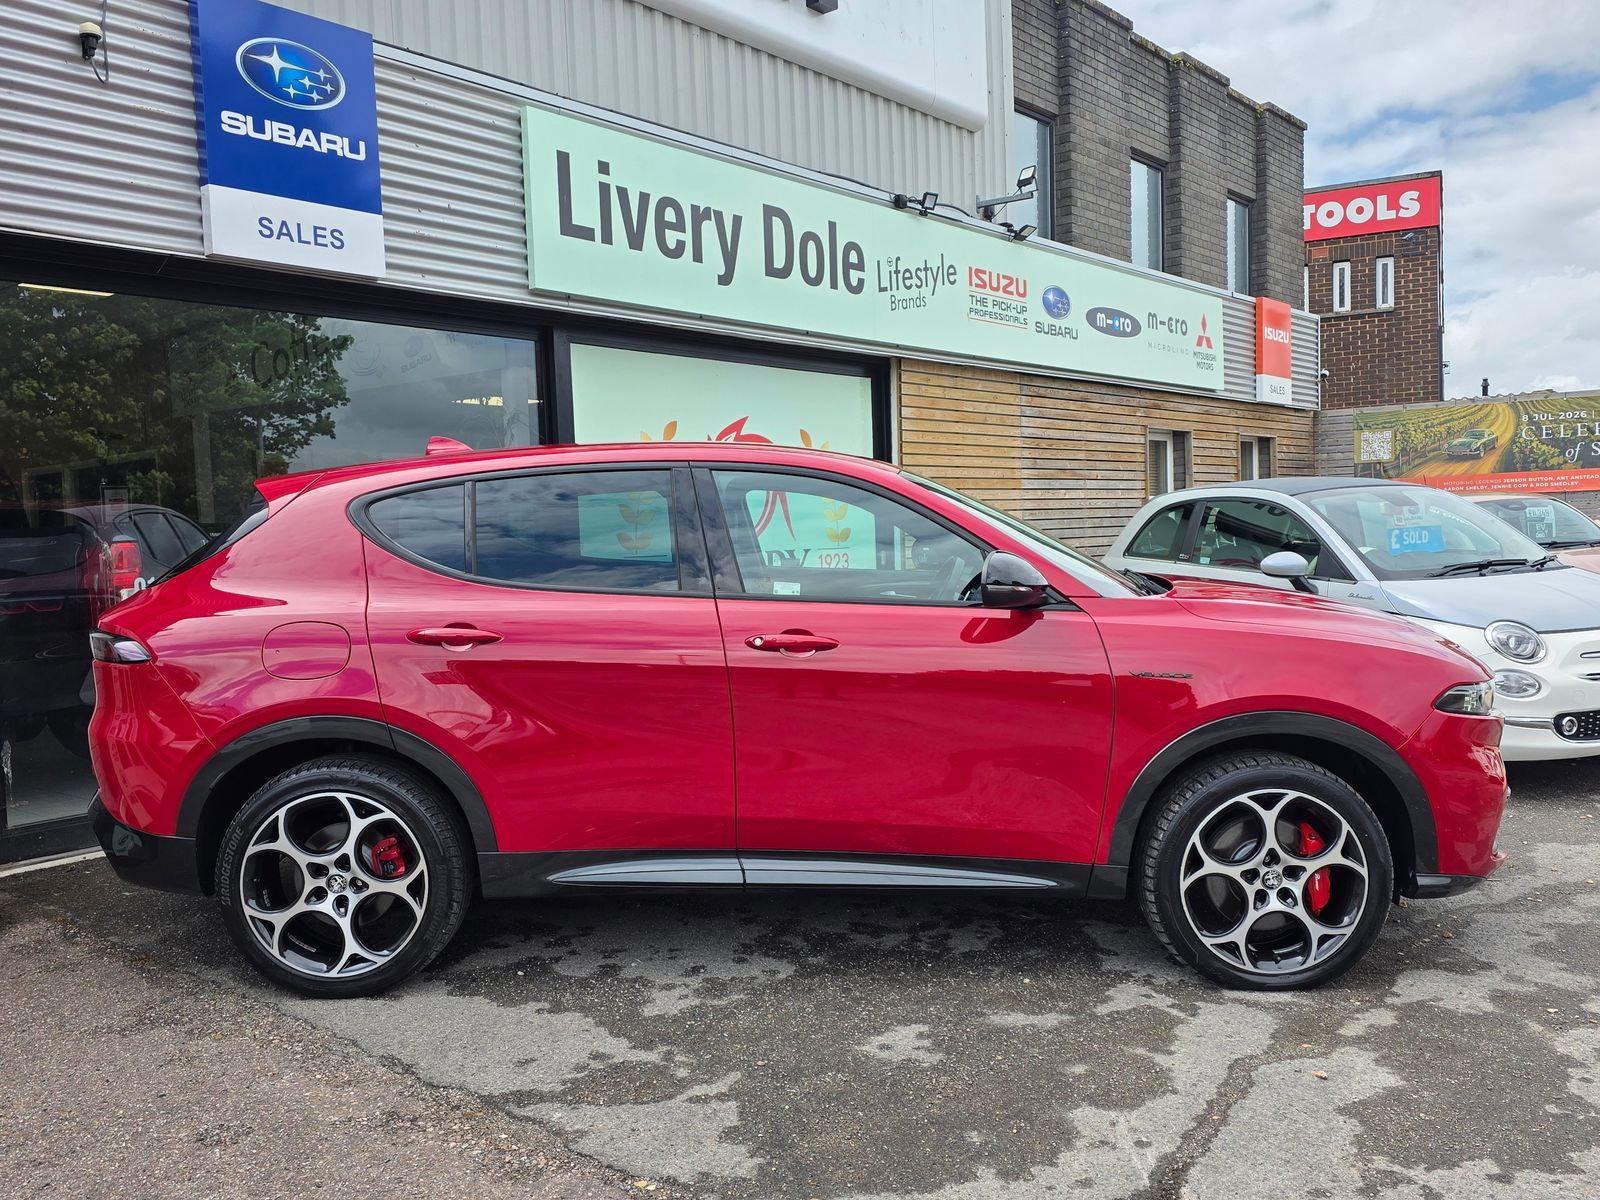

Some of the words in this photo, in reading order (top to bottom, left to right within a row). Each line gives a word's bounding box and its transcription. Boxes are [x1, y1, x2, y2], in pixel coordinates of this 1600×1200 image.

[220, 110, 366, 161] SUBARU
[1303, 190, 1421, 230] TOOLS
[555, 149, 743, 287] Livery
[762, 203, 866, 296] Dole
[257, 216, 345, 250] SALES
[876, 252, 957, 297] Lifestyle
[968, 266, 1028, 299] ISUZU
[890, 290, 927, 311] Brands
[968, 294, 989, 308] THE
[992, 299, 1028, 315] PICK-UP
[968, 307, 1028, 326] PROFESSIONALS
[1034, 321, 1079, 340] SUBARU
[1264, 326, 1290, 344] ISUZU
[1192, 350, 1217, 363] MITSUBISHI
[1196, 360, 1215, 372] MOTORS
[1269, 384, 1286, 396] SALES
[1522, 414, 1529, 422] 8
[1533, 412, 1555, 421] JUL
[1558, 410, 1588, 420] 2026
[1565, 441, 1585, 463] of
[1403, 530, 1429, 545] SOLD
[818, 552, 850, 568] 1923
